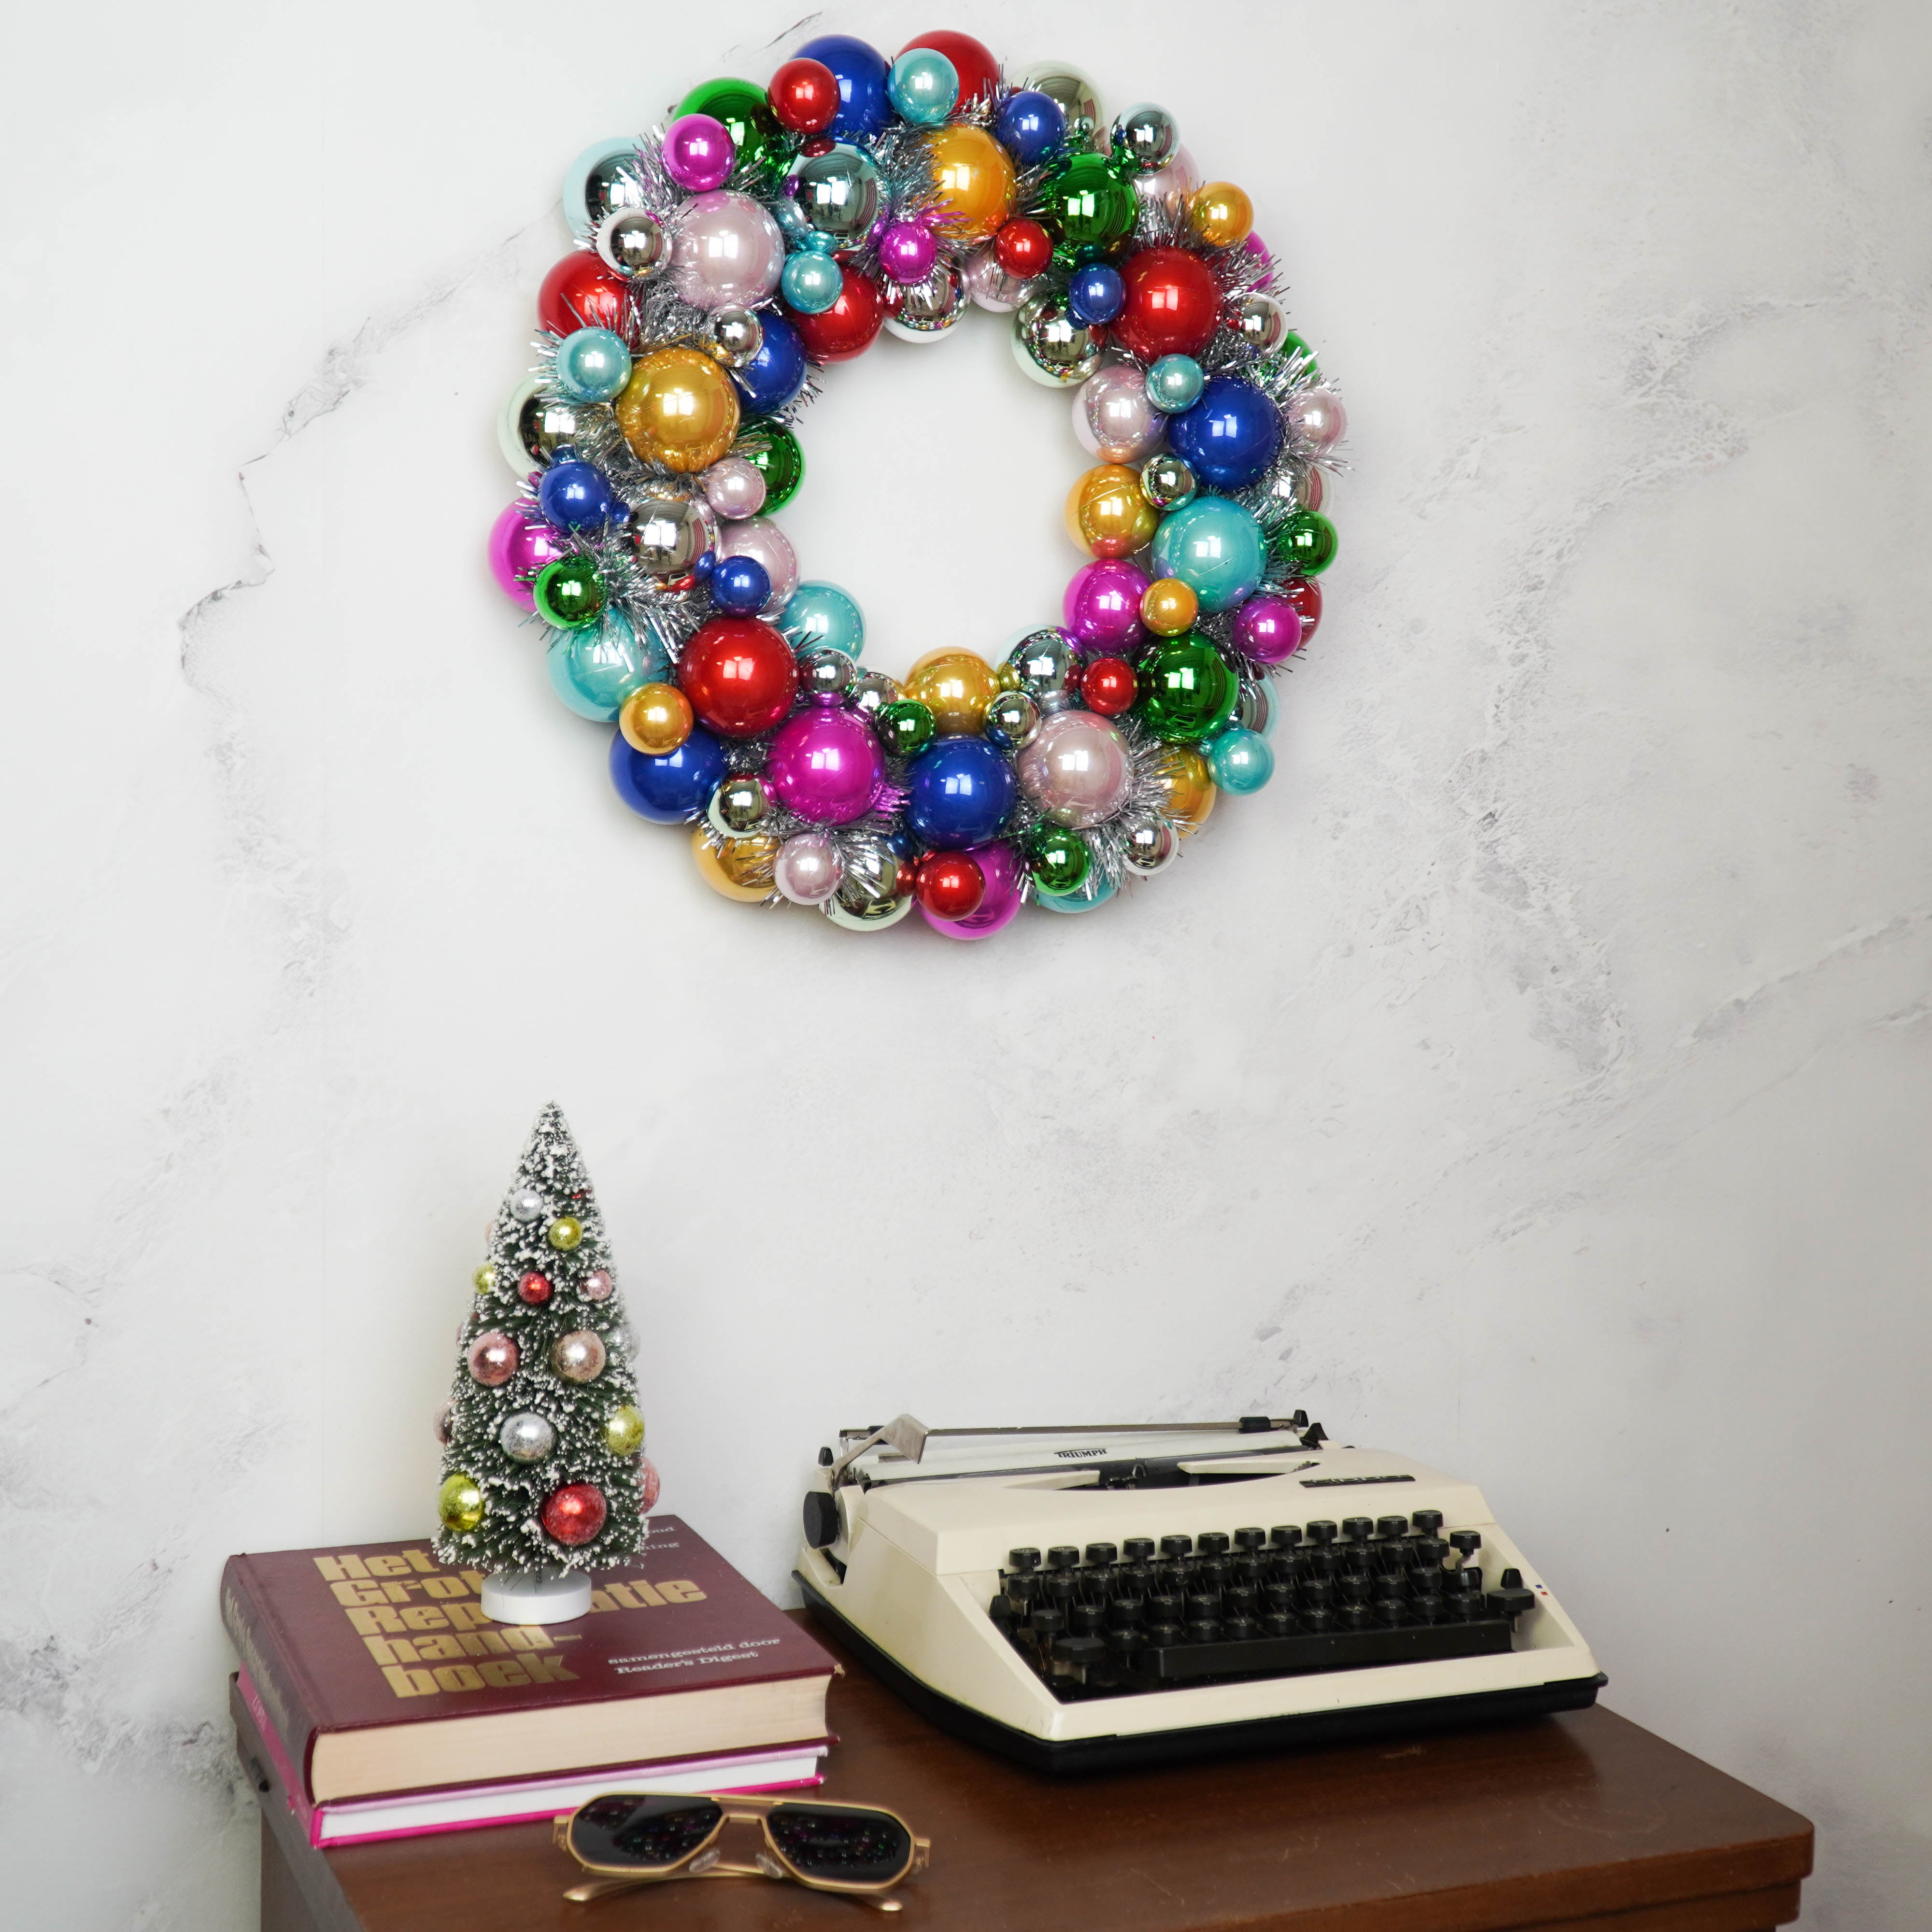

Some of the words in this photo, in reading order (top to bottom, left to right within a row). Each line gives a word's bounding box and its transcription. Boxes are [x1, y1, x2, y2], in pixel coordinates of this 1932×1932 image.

[1053, 1448, 1107, 1458] TRIUMPH
[313, 1548, 440, 1581] Het
[329, 1570, 485, 1607] Grot
[361, 1624, 583, 1665] hand-
[608, 1643, 736, 1665] samengesteld
[739, 1638, 781, 1648] door
[381, 1653, 581, 1698] boek
[614, 1660, 695, 1675] Reader's
[697, 1651, 759, 1664] Digest
